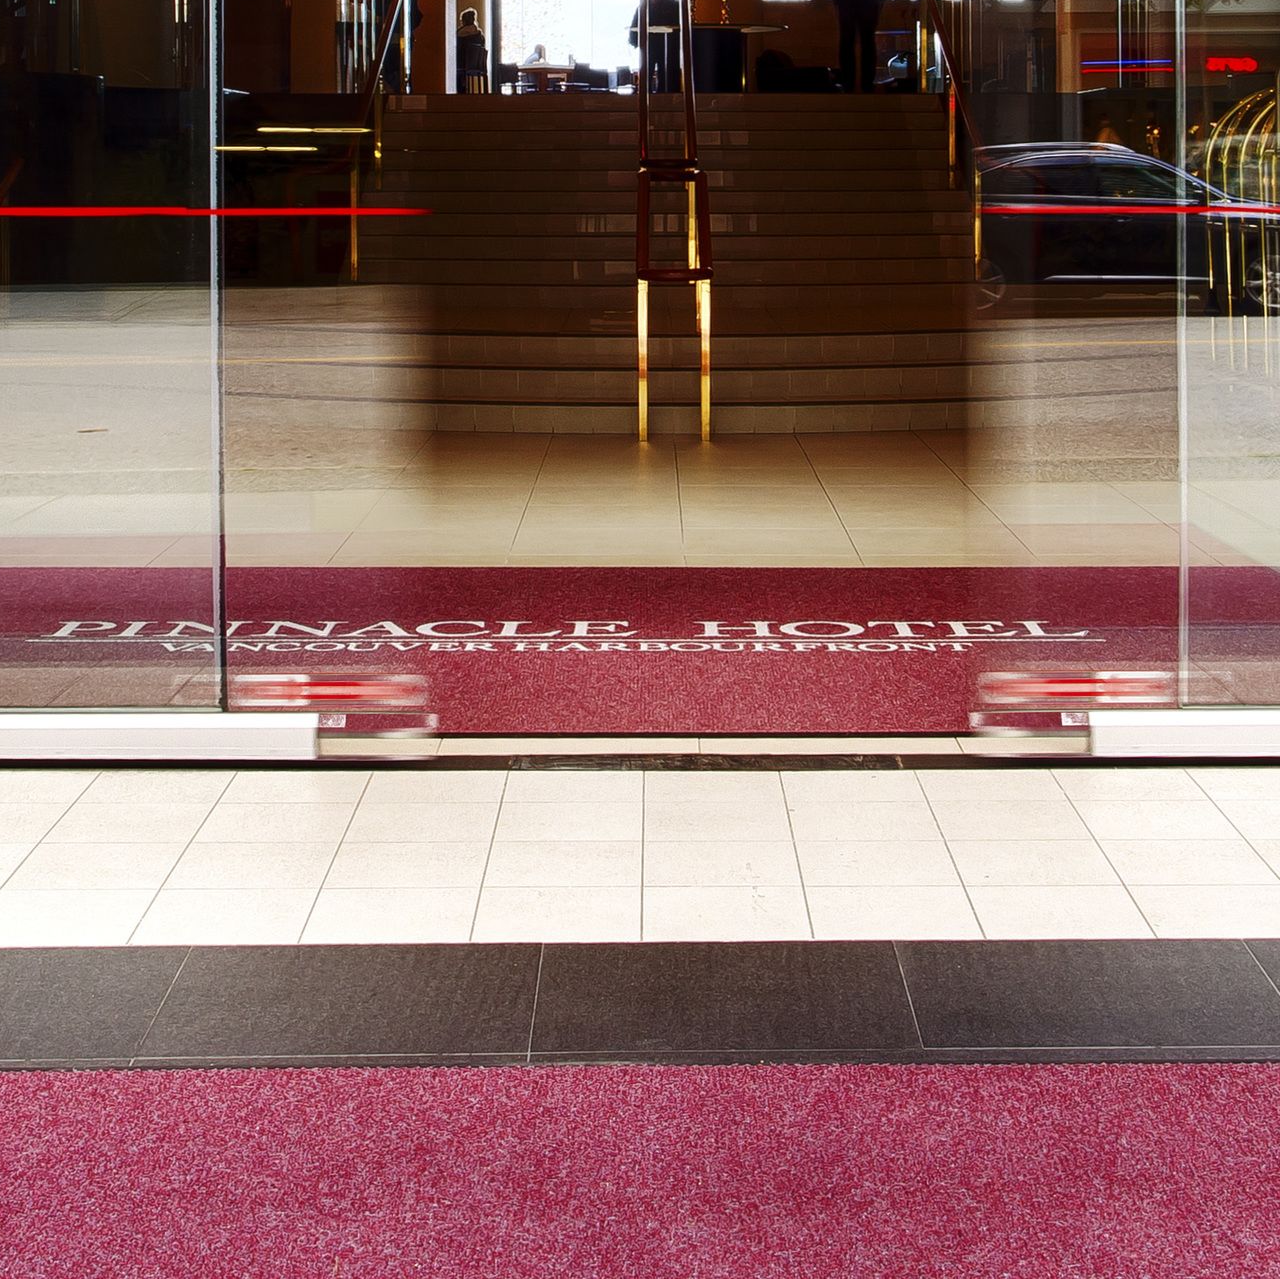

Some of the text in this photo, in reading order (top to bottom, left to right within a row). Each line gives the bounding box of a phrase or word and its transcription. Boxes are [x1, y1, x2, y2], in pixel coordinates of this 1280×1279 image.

[40, 619, 1090, 639] PINNACLE HOTEL
[160, 641, 973, 653] VANCOUVER HARBOURFRONT
